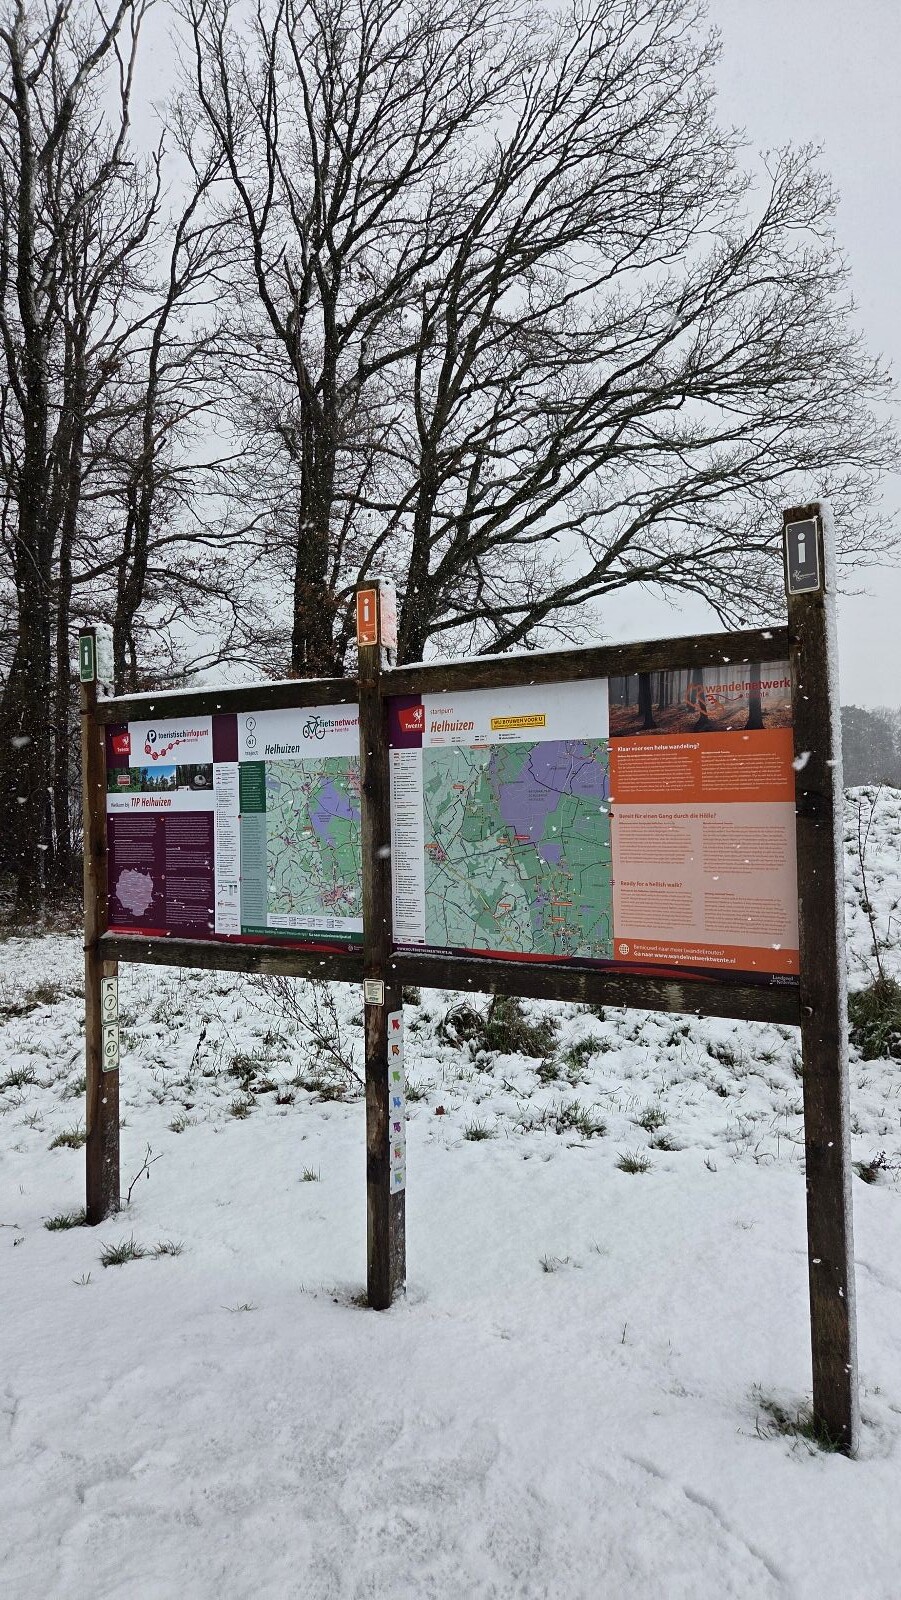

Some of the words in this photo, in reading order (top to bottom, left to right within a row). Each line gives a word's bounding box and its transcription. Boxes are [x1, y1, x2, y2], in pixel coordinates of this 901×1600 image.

[706, 677, 791, 693] wandelnetwerk
[429, 707, 454, 715] startpunt
[430, 720, 475, 733] Helhuizen
[158, 729, 209, 739] toeristischinfopunt
[265, 744, 300, 755] Helhuizen
[668, 742, 700, 750] wandeling?
[131, 798, 141, 807] TIP
[141, 797, 172, 807] Helhuizen
[654, 953, 736, 963] www.wandelnetwerktwente.nl
[108, 998, 113, 1007] 7
[106, 1045, 116, 1054] 61
